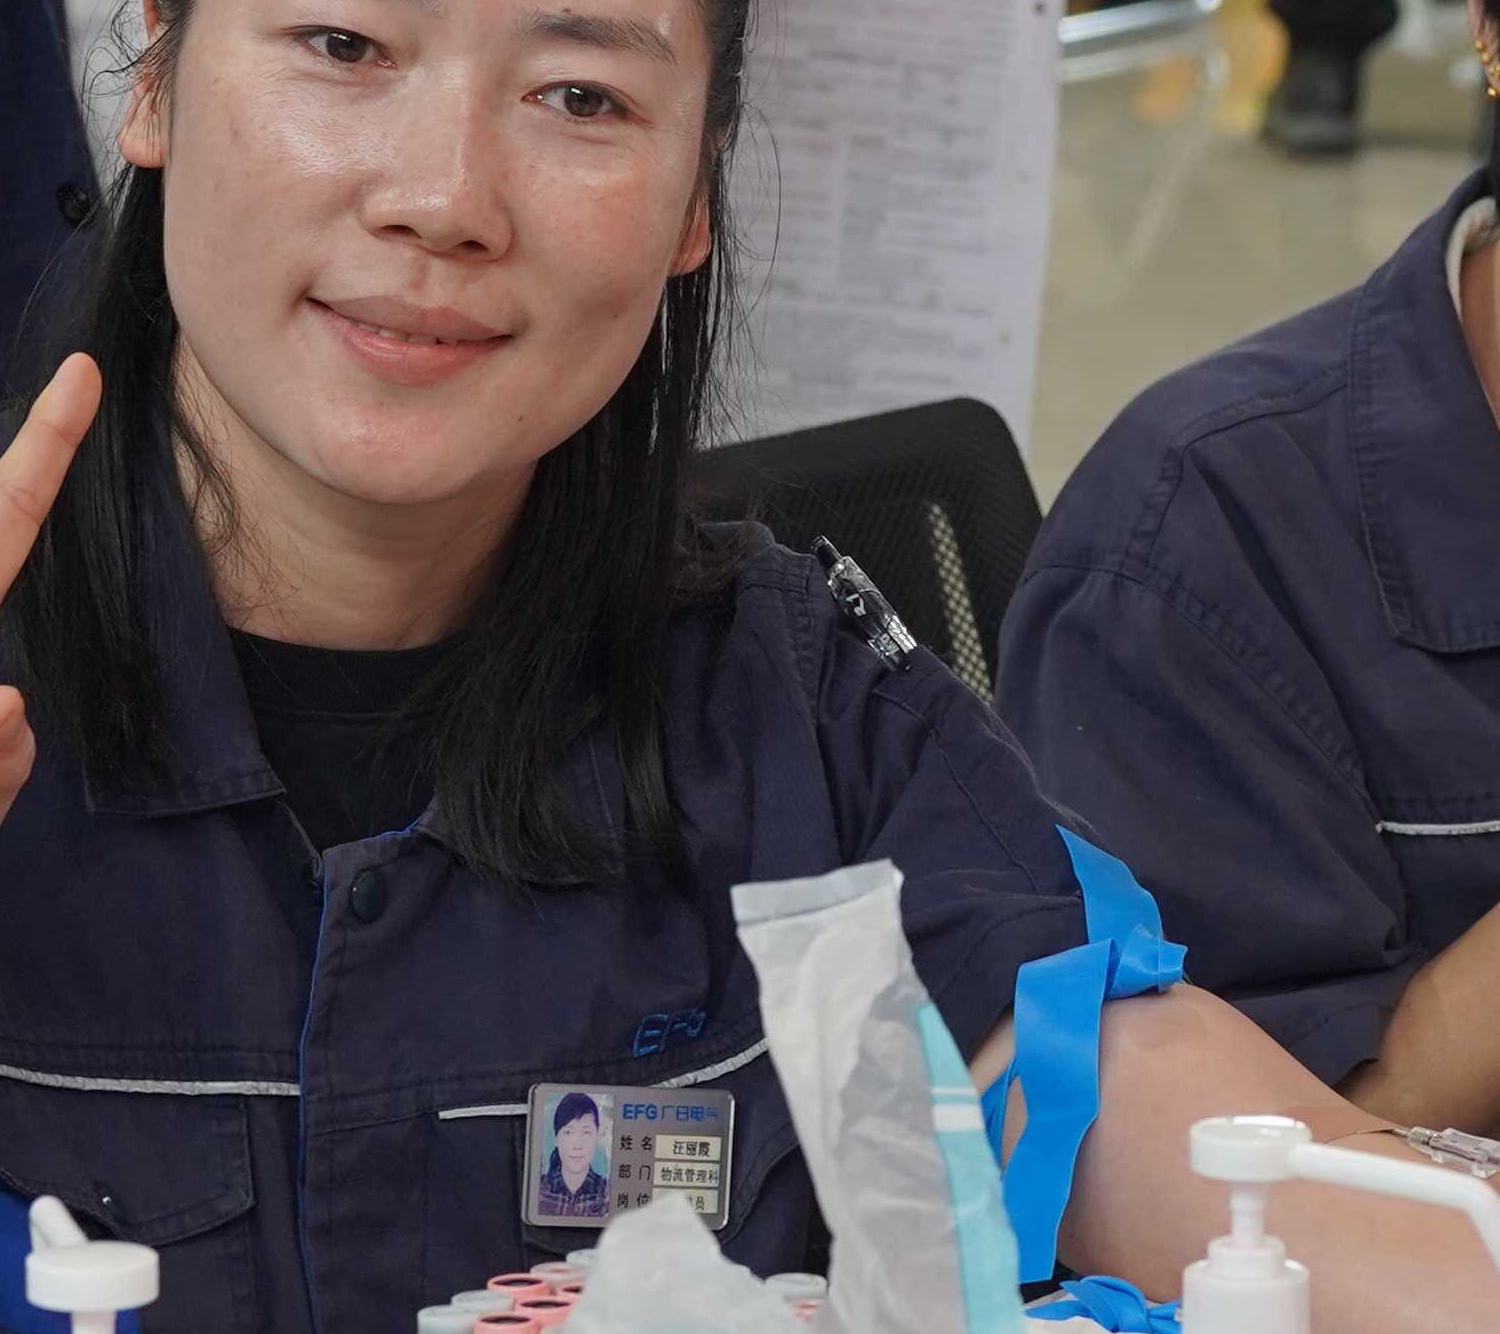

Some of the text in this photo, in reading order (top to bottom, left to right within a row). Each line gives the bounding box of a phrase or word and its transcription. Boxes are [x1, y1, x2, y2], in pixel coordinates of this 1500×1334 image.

[622, 1104, 658, 1120] EFG
[619, 1135, 653, 1152] 姓名
[618, 1164, 652, 1181] 部门
[616, 1193, 652, 1209] 岗位
